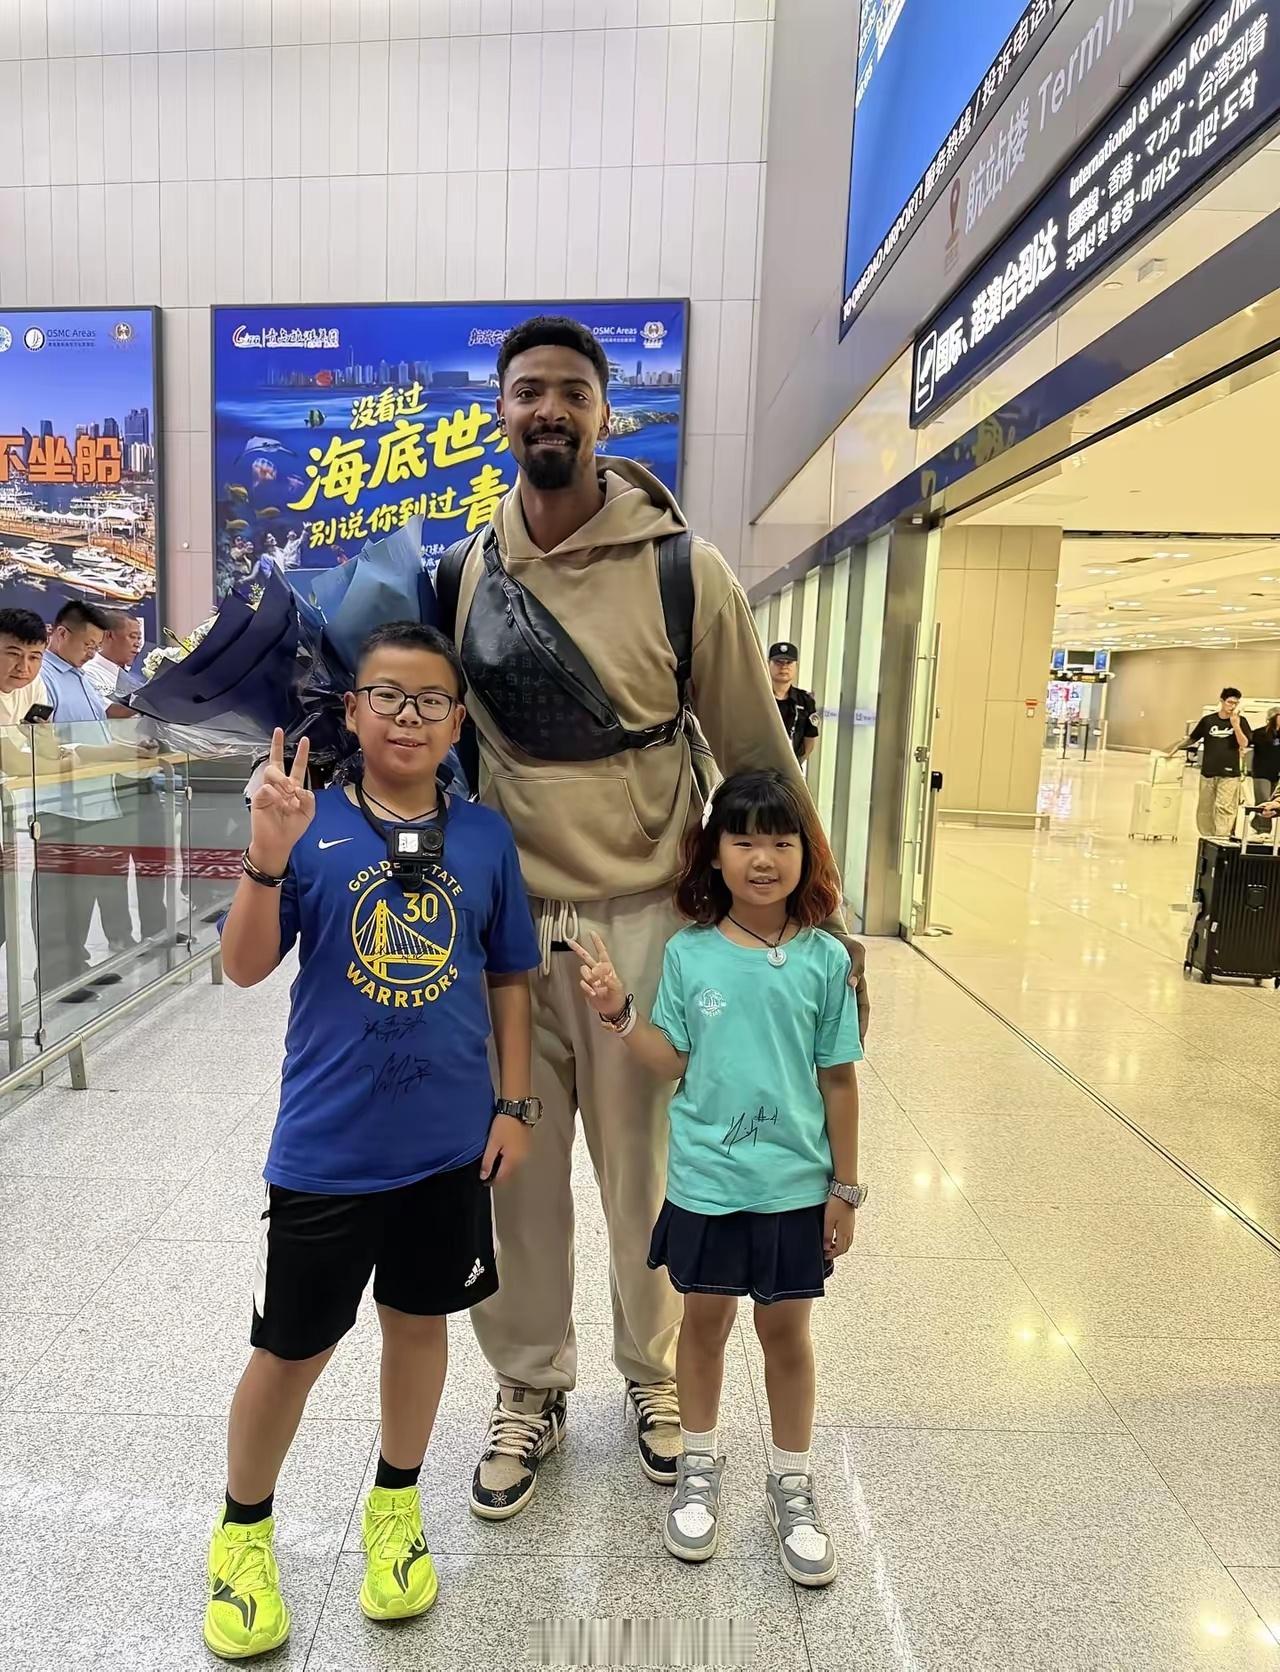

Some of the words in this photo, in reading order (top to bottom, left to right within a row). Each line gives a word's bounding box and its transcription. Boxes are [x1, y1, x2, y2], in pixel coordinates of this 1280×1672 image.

[1070, 106, 1137, 198] International
[1138, 97, 1150, 124] &
[1151, 58, 1187, 111] Hong
[1189, 0, 1257, 70] Kong/M
[966, 97, 1030, 235] 航站楼
[1097, 211, 1109, 247] 및
[1221, 69, 1258, 130] 도착
[73, 329, 96, 337] Areas
[593, 326, 615, 335] OSMC
[616, 326, 637, 335] Areas
[350, 381, 428, 431] 没看过
[287, 403, 510, 511] 海底世
[348, 860, 401, 892] GOLD
[422, 864, 463, 897] TATE
[402, 892, 439, 923] 30
[346, 961, 459, 1008] WARRIORS
